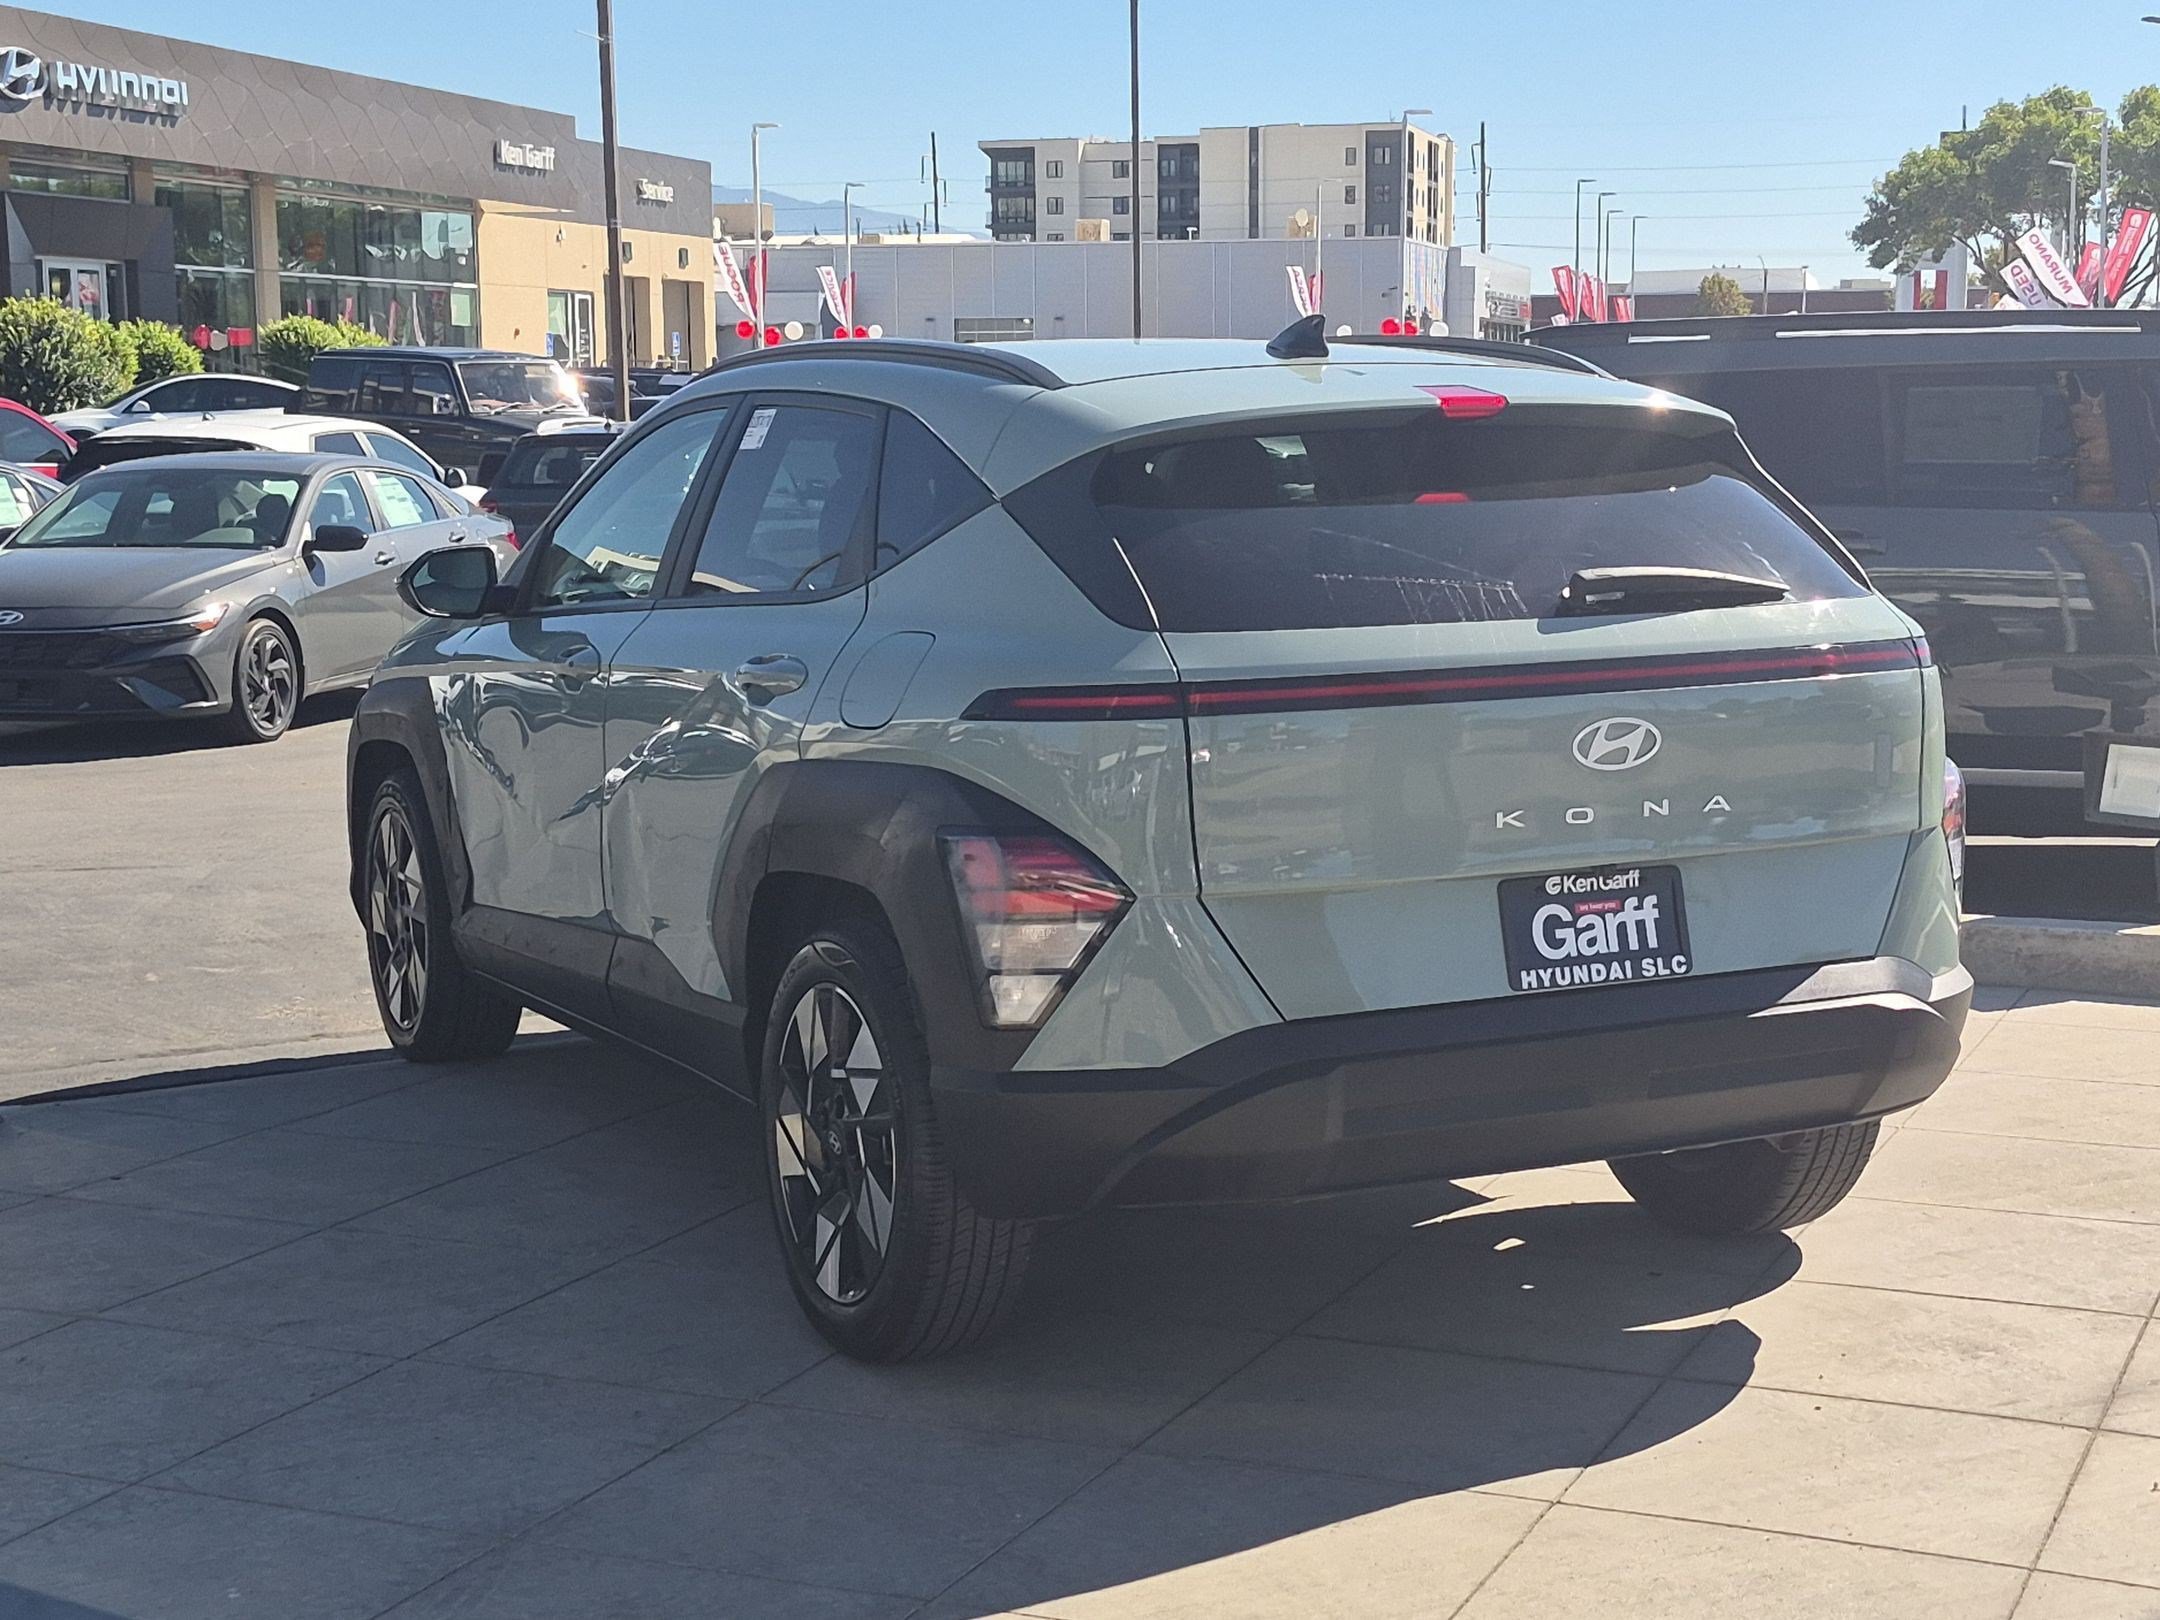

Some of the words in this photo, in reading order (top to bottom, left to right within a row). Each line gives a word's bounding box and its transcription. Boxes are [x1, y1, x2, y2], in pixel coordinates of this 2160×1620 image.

[56, 61, 189, 105] HYUNDAI
[500, 140, 523, 166] Ken
[523, 144, 556, 171] Garff
[638, 178, 674, 203] Service
[1496, 795, 1732, 829] KONA
[1562, 875, 1598, 894] Ken
[1599, 869, 1641, 891] Garff
[1532, 895, 1660, 960] Garff
[1520, 960, 1633, 989] HYUNDAI
[1641, 955, 1688, 977] SLC
